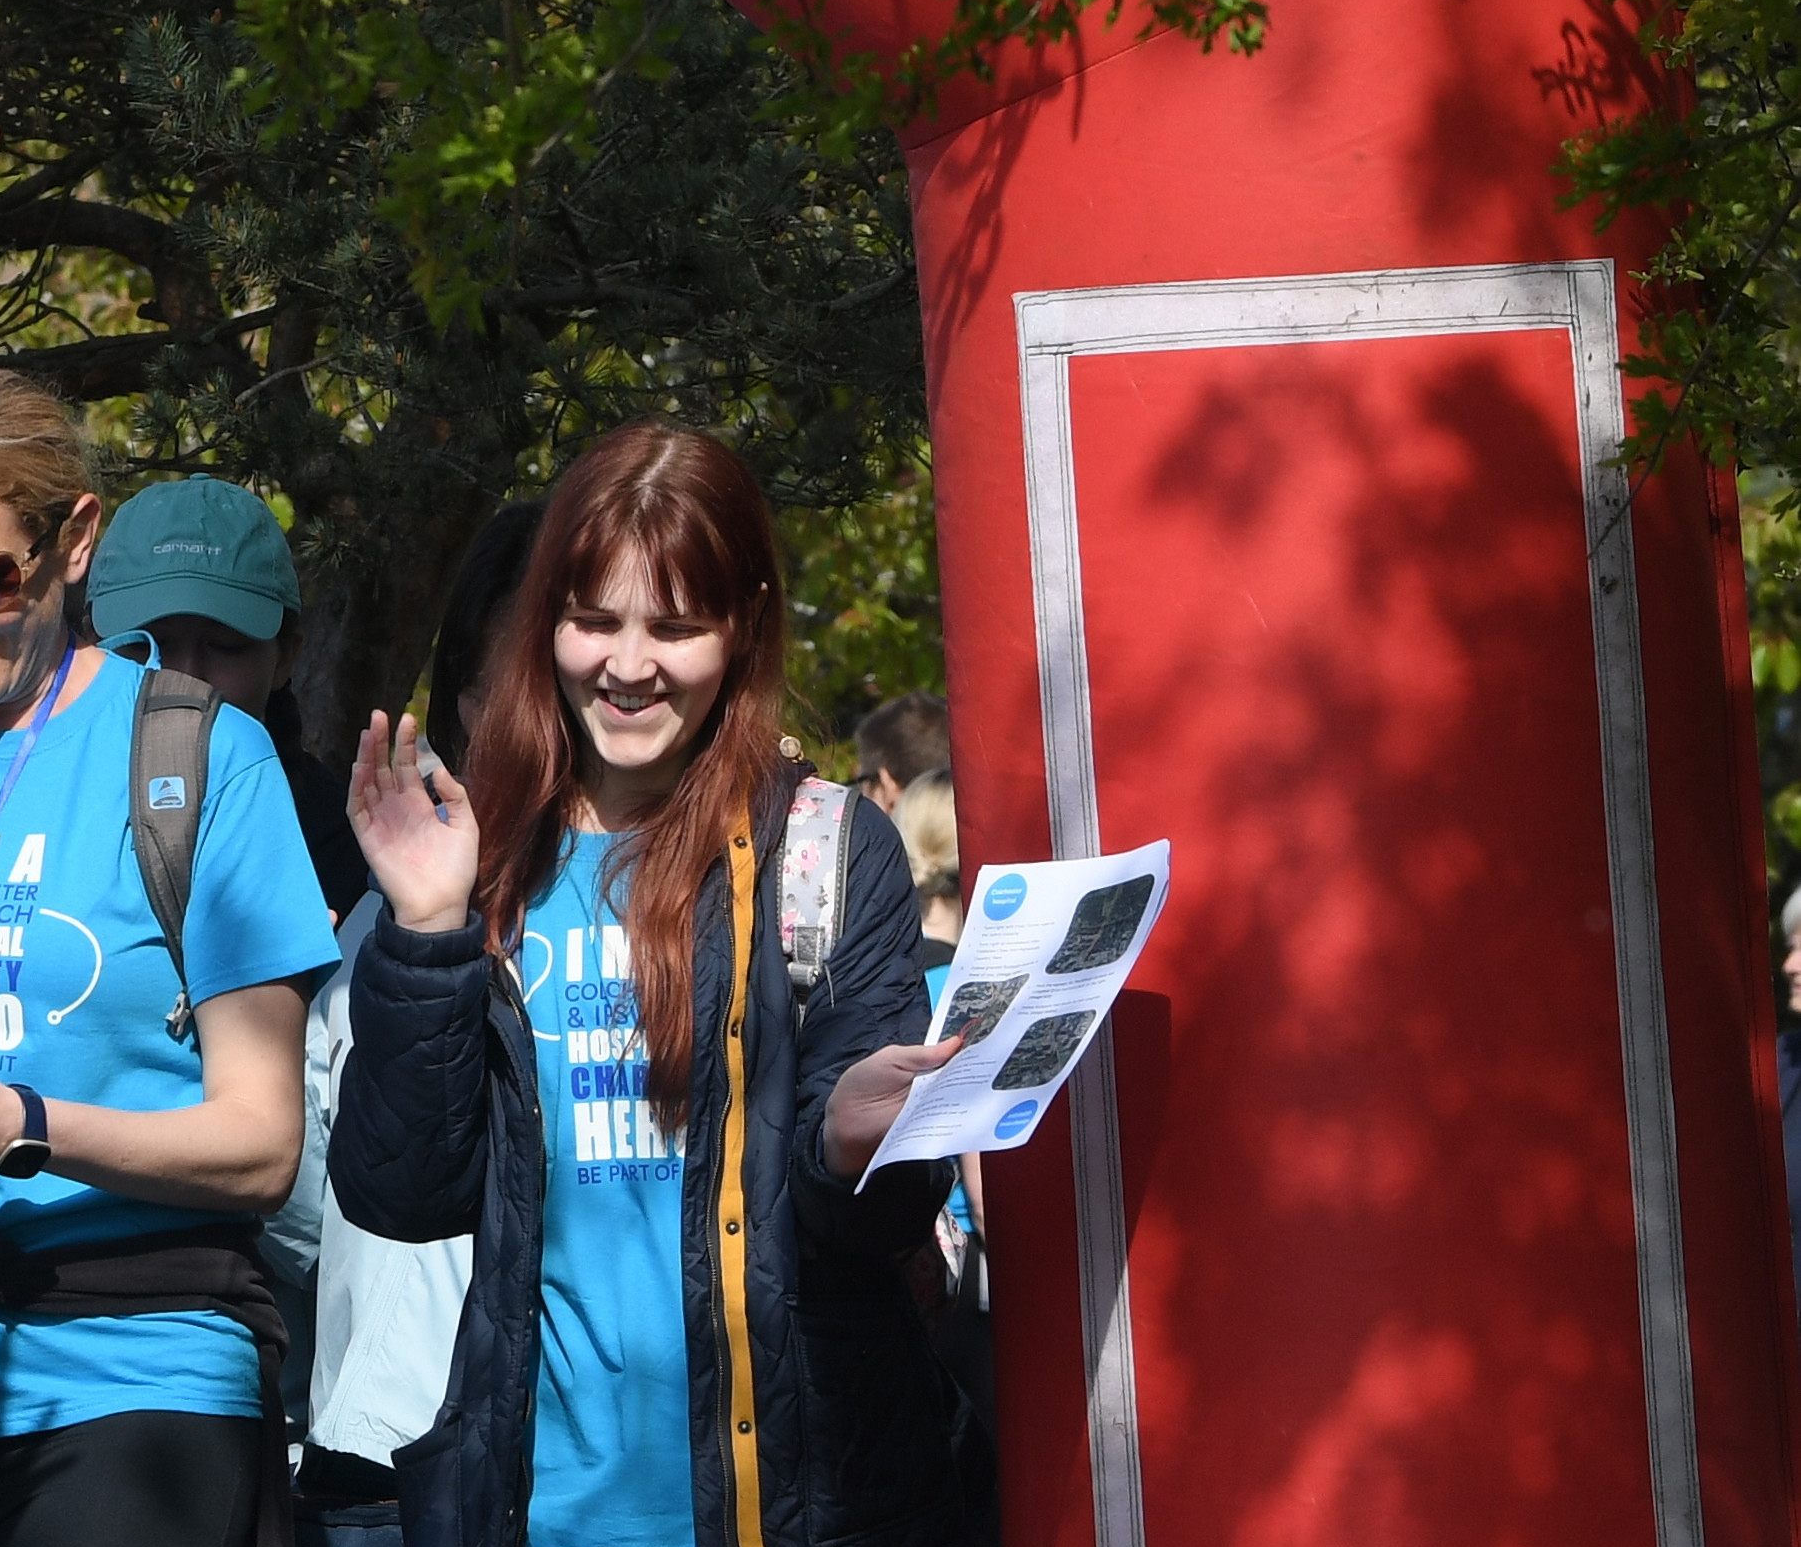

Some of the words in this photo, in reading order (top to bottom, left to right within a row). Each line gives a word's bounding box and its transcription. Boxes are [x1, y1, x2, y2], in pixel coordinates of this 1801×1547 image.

[8, 833, 46, 883] A
[567, 1006, 585, 1028] &
[0, 1055, 17, 1072] IT
[570, 1064, 649, 1100] CHAR
[577, 1166, 602, 1185] BE
[609, 1164, 649, 1183] PART
[655, 1163, 680, 1181] OF
